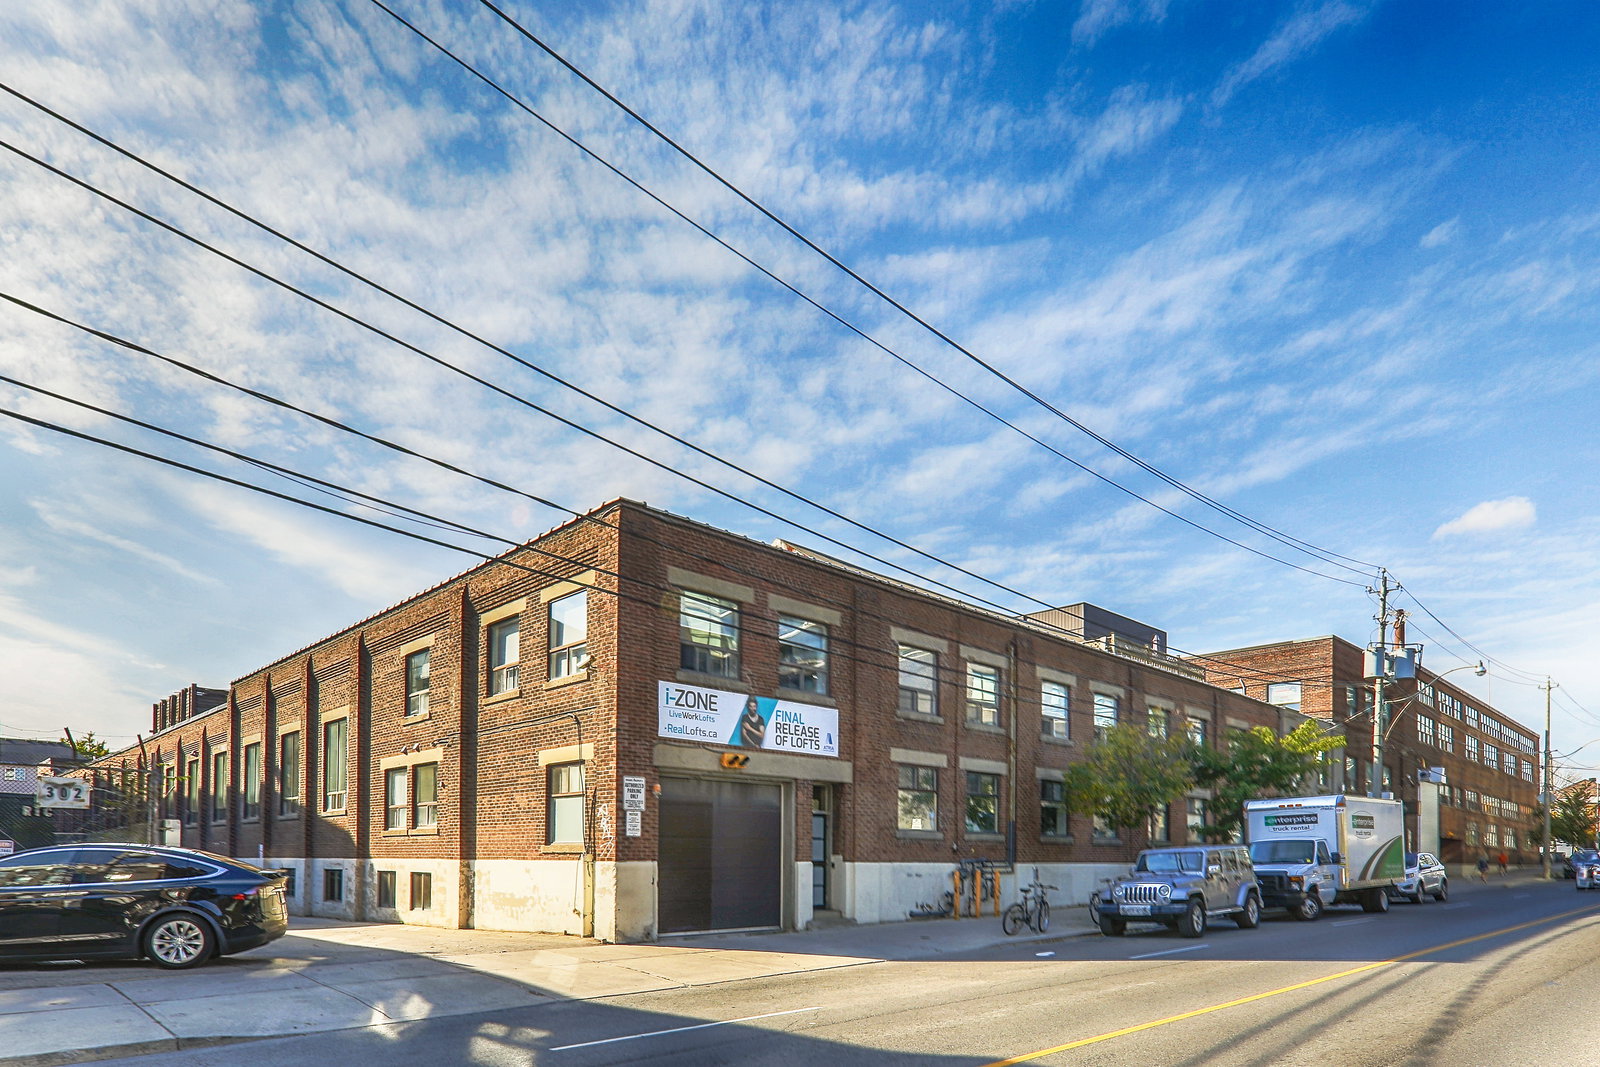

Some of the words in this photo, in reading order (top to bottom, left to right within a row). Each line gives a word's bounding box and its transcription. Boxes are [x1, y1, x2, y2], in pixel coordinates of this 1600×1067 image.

[665, 687, 718, 712] i-ZONE
[668, 710, 716, 723] LiveWorkLofts
[775, 709, 805, 725] FINAL
[775, 722, 820, 739] RELEASE
[775, 734, 788, 747] OF
[790, 735, 820, 751] LOFTS
[46, 786, 82, 799] 302
[1267, 814, 1318, 825] enterprise
